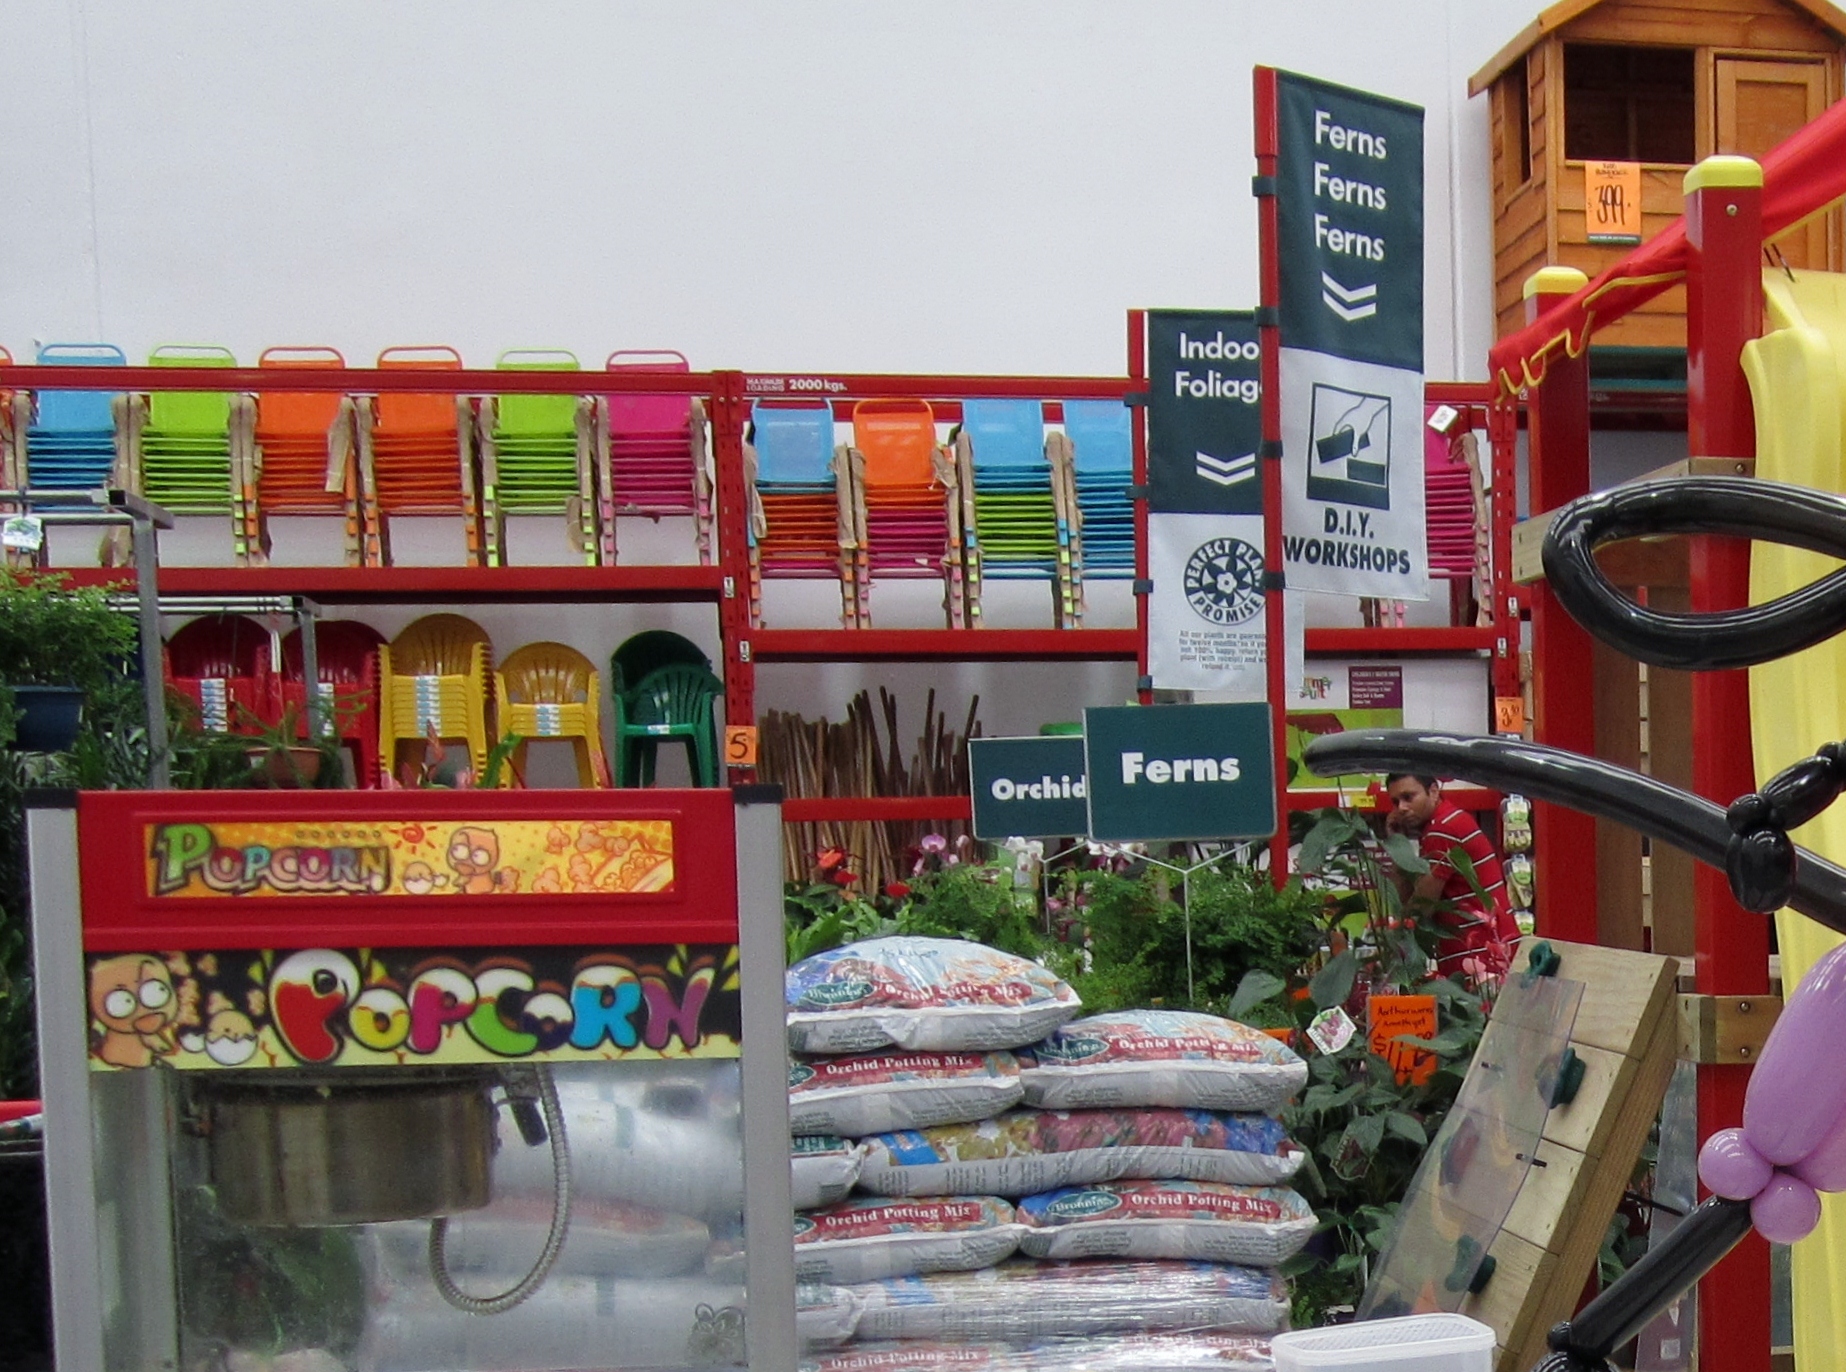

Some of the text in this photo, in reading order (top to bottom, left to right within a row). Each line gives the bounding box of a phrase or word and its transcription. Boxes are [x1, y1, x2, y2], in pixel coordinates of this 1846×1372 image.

[1315, 110, 1387, 160] Ferns
[1314, 162, 1387, 211] Ferns
[1315, 214, 1385, 261] Ferns
[789, 379, 821, 391] 2000
[1324, 507, 1375, 538] D.I.Y.
[1187, 539, 1231, 588] PERFECT
[1283, 535, 1411, 574] WORKSHOPS
[1193, 596, 1262, 622] PROMISE
[1121, 752, 1241, 784] Ferns
[991, 775, 1087, 800] Orchid
[826, 1058, 878, 1076] Orchid
[884, 1055, 940, 1073] Potting
[826, 1204, 971, 1227] Orchid Potting Mix
[1131, 1194, 1274, 1215] Orchid Potting Mix
[831, 1355, 883, 1369] Orchid
